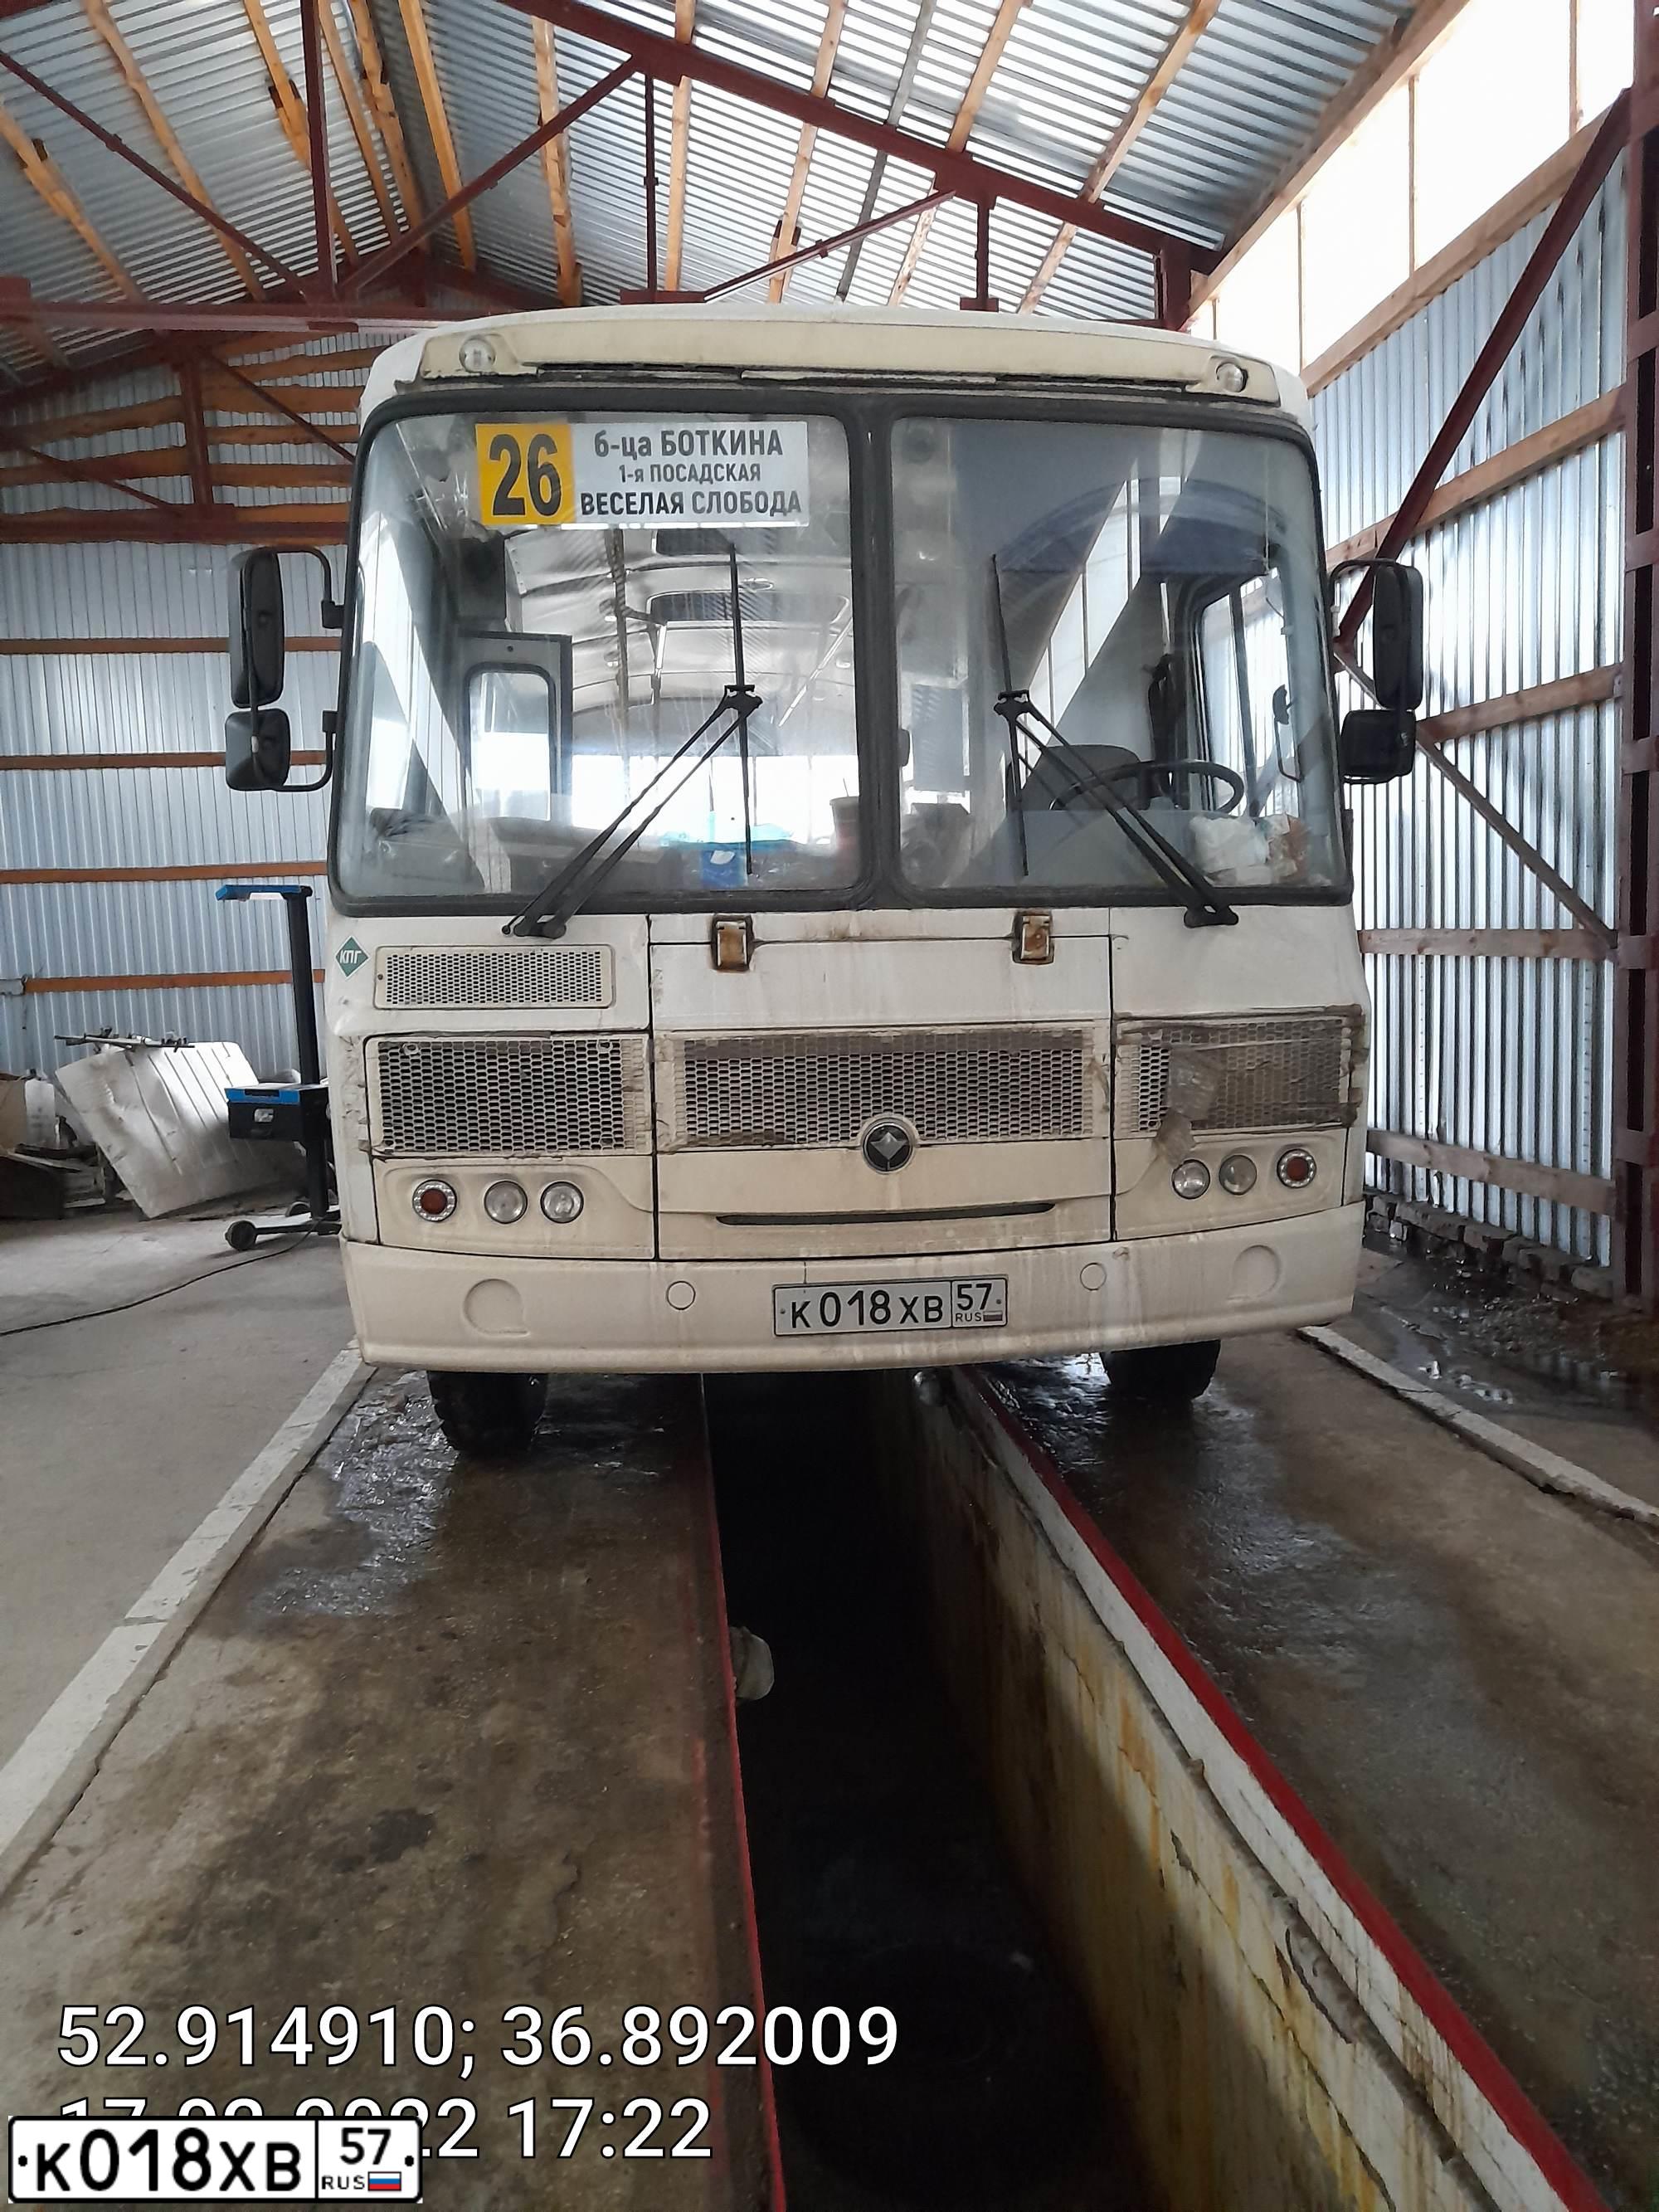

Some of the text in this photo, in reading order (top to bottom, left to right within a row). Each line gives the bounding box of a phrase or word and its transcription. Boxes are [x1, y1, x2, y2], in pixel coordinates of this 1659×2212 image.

[594, 430, 783, 460] б-ца БОТКИНА
[489, 433, 562, 517] 26
[619, 463, 761, 485] 1-я ПОСАДСКАЯ
[581, 490, 802, 517] ВЕСЕЛАЯ СЛОБОДА
[956, 1283, 993, 1311] 57
[955, 1313, 982, 1323] RUS
